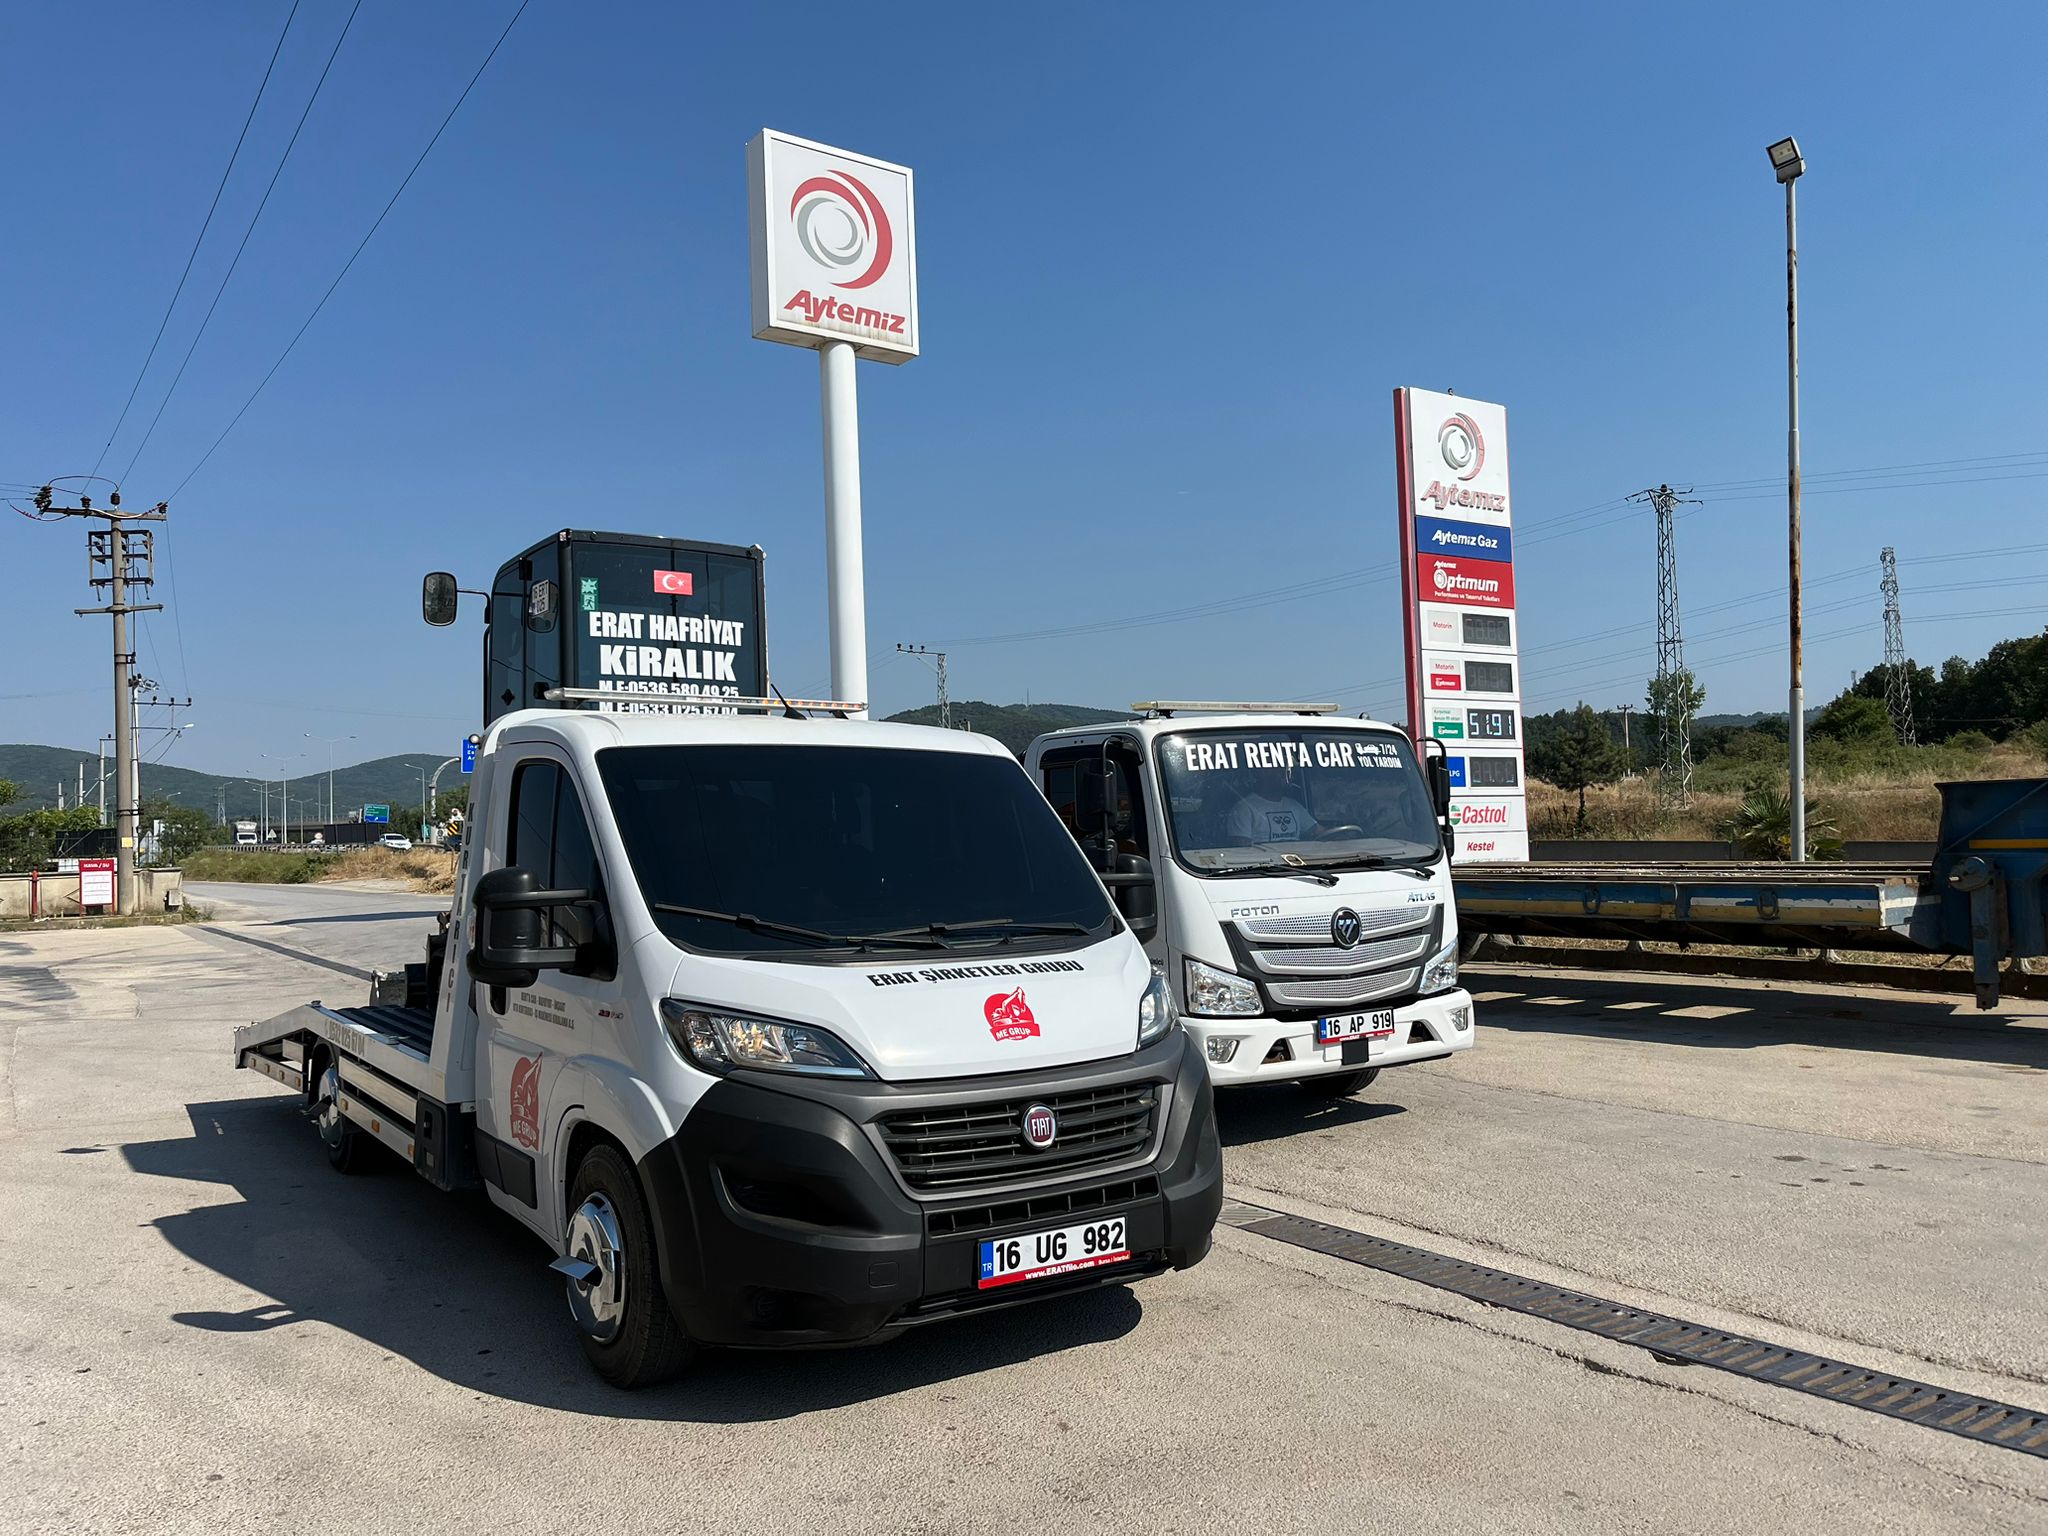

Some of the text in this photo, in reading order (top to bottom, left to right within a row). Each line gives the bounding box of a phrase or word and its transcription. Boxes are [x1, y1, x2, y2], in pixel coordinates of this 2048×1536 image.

[784, 290, 906, 334] Aytemiz
[1420, 481, 1505, 512] Aytemiz
[1432, 530, 1499, 549] Aytemiz Gaz
[589, 611, 744, 647] ERAT HAFRİYAT
[1433, 621, 1452, 630] Motorin
[1469, 713, 1513, 736] 51.91
[1185, 742, 1356, 771] ERAT RENT'A CAR
[1379, 743, 1398, 756] 7/24
[1357, 755, 1402, 768] YOL YARDIM
[1462, 805, 1507, 824] Castrol
[1467, 841, 1495, 851] Kestel
[1408, 892, 1436, 903] ATLAS
[1231, 905, 1280, 918] FOTON
[866, 960, 1085, 987] ERAT ŞİRKETLER GRUBU
[995, 1027, 1031, 1039] ME GRUP
[1328, 1012, 1391, 1036] 16 AP 919
[1031, 1117, 1050, 1137] FIAT
[996, 1221, 1124, 1272] 16 UG 982
[982, 1263, 993, 1272] TR
